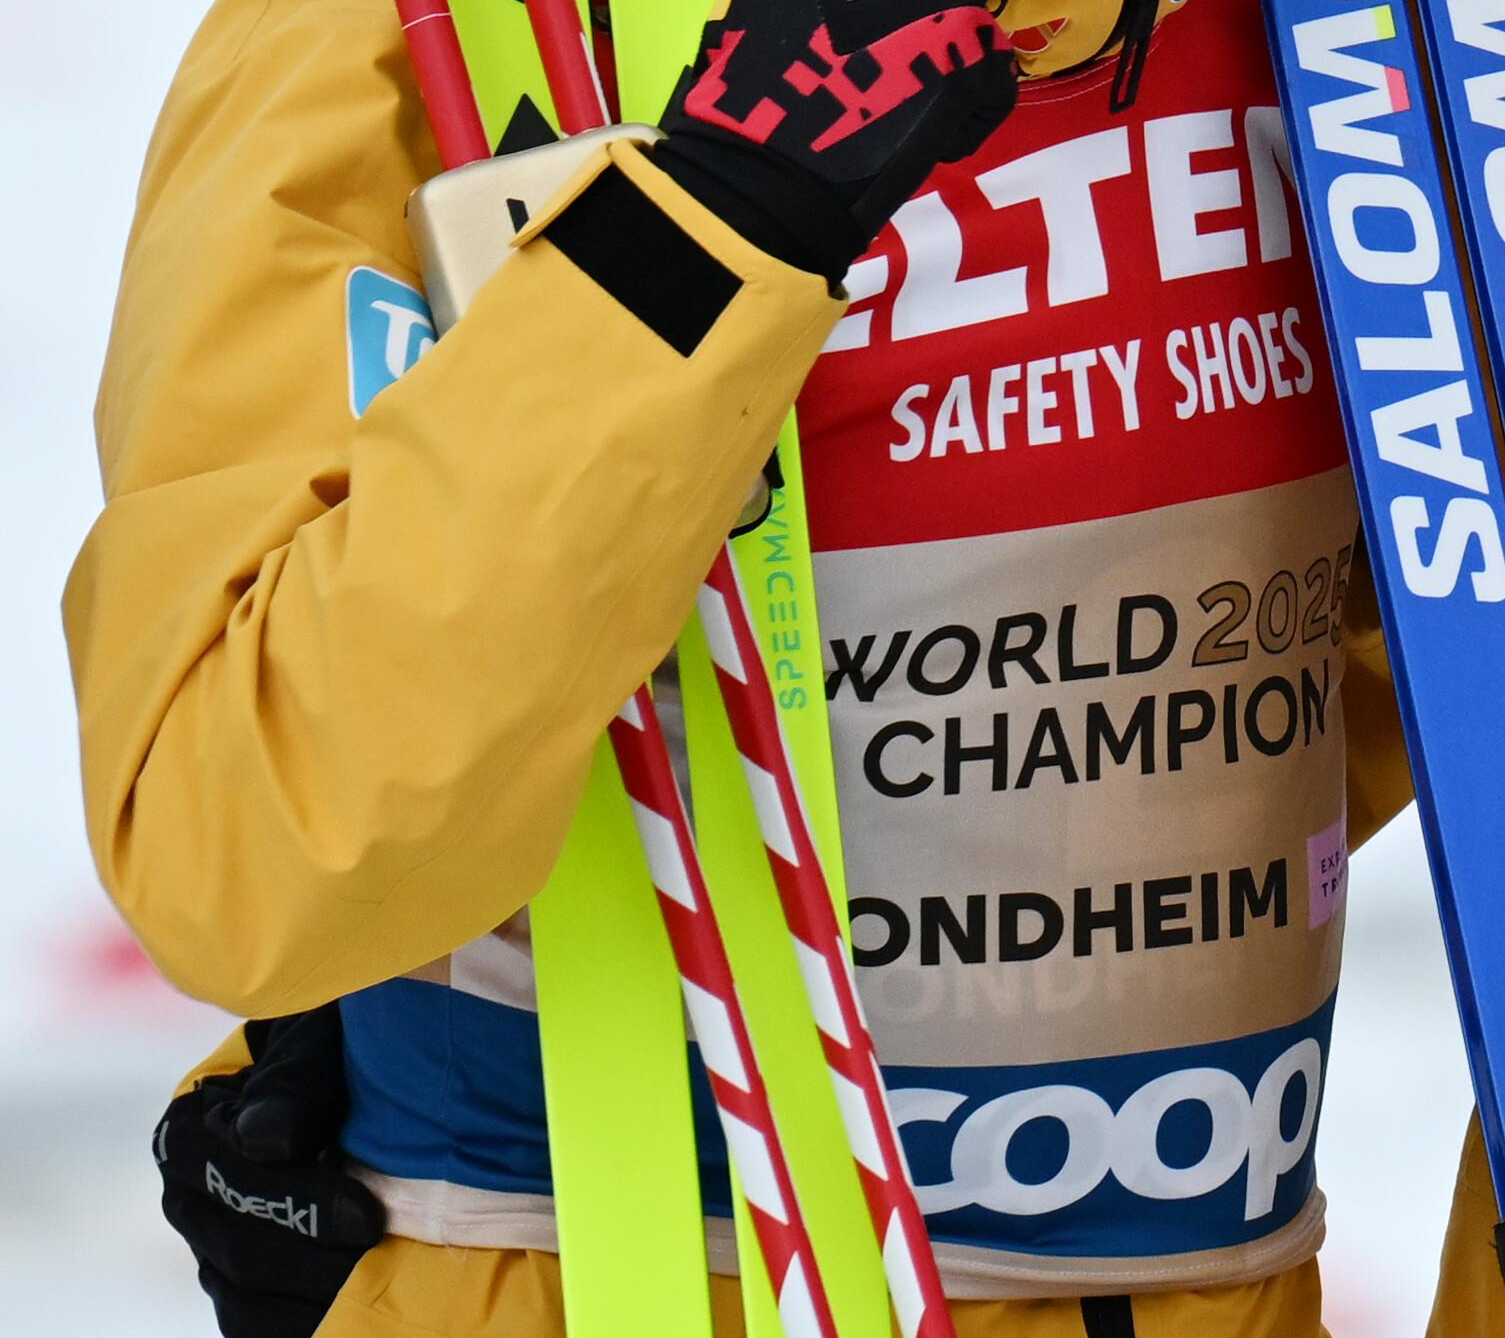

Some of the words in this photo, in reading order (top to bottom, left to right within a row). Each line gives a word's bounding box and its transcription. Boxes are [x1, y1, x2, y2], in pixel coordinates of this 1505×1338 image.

[889, 338, 1142, 463] SAFETY
[1165, 306, 1314, 421] SHOES
[825, 592, 1177, 704] WORLD
[1188, 542, 1353, 667] 2025
[862, 660, 1330, 799] CHAMPION
[884, 1036, 1322, 1223] coop
